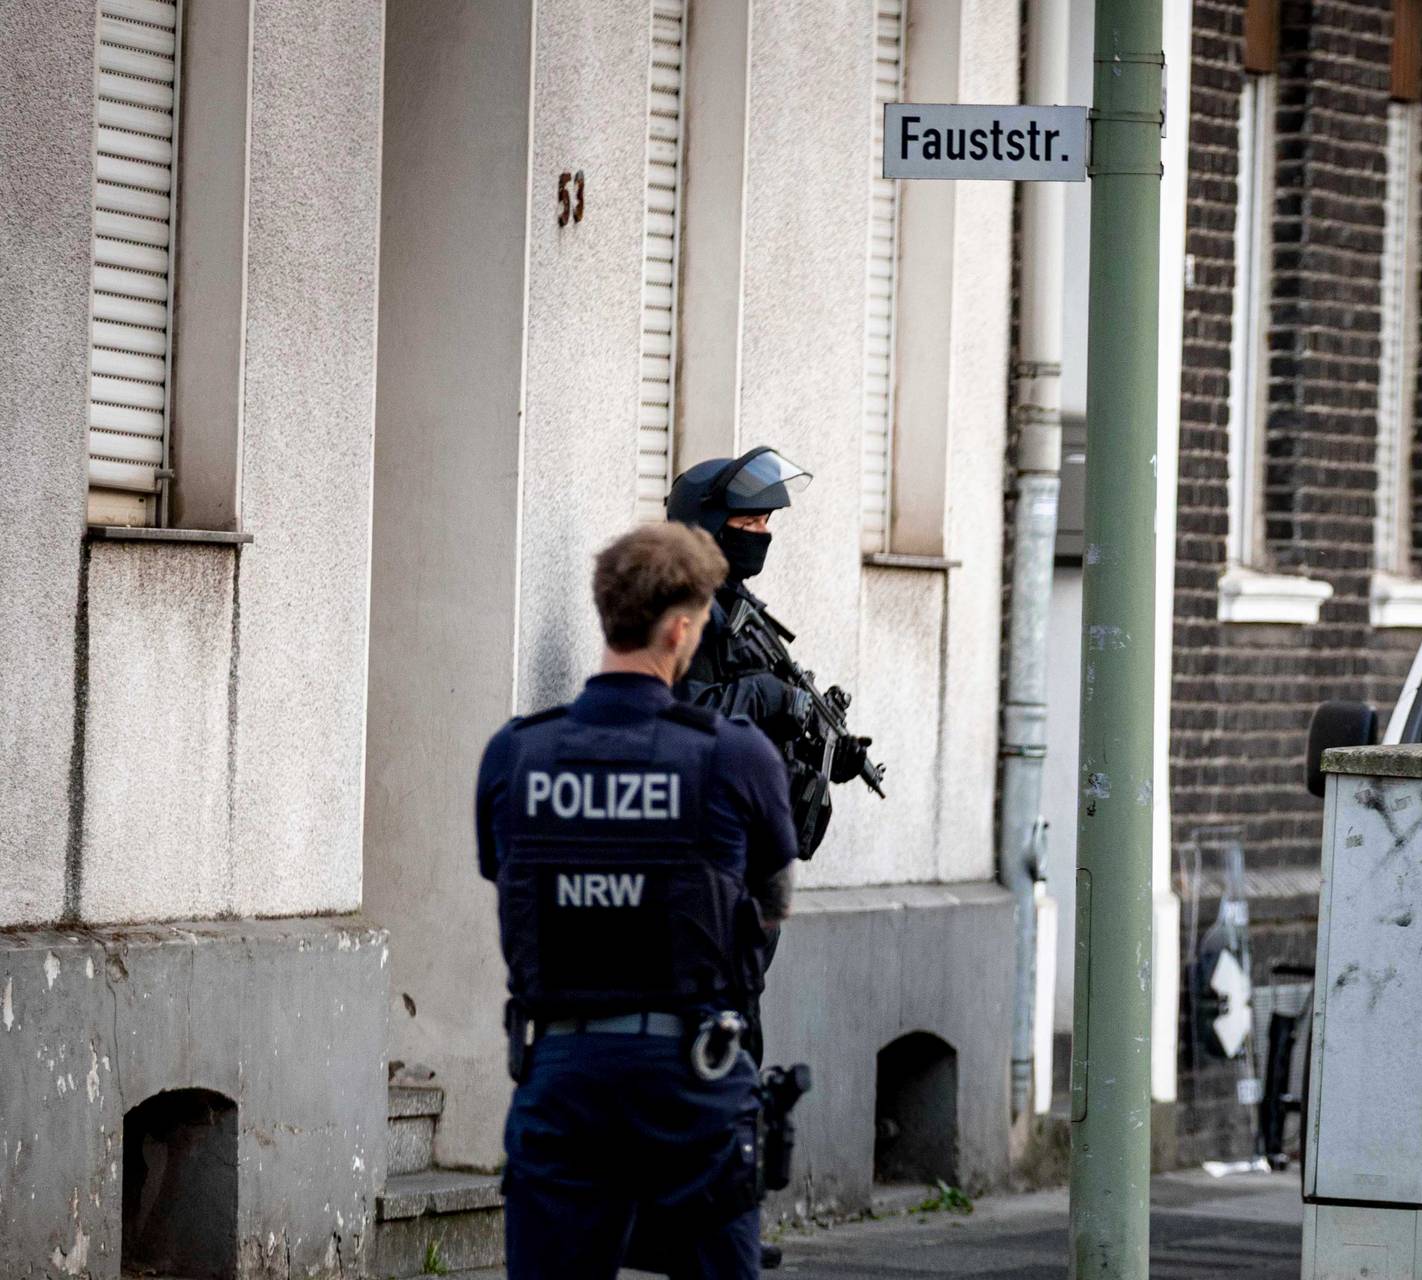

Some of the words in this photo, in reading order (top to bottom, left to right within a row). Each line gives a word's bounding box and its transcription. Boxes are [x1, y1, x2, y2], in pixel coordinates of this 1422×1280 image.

[901, 116, 1069, 162] Fauststr.
[558, 170, 584, 228] 53
[527, 771, 681, 820] POLIZEI
[557, 873, 645, 908] NRW
